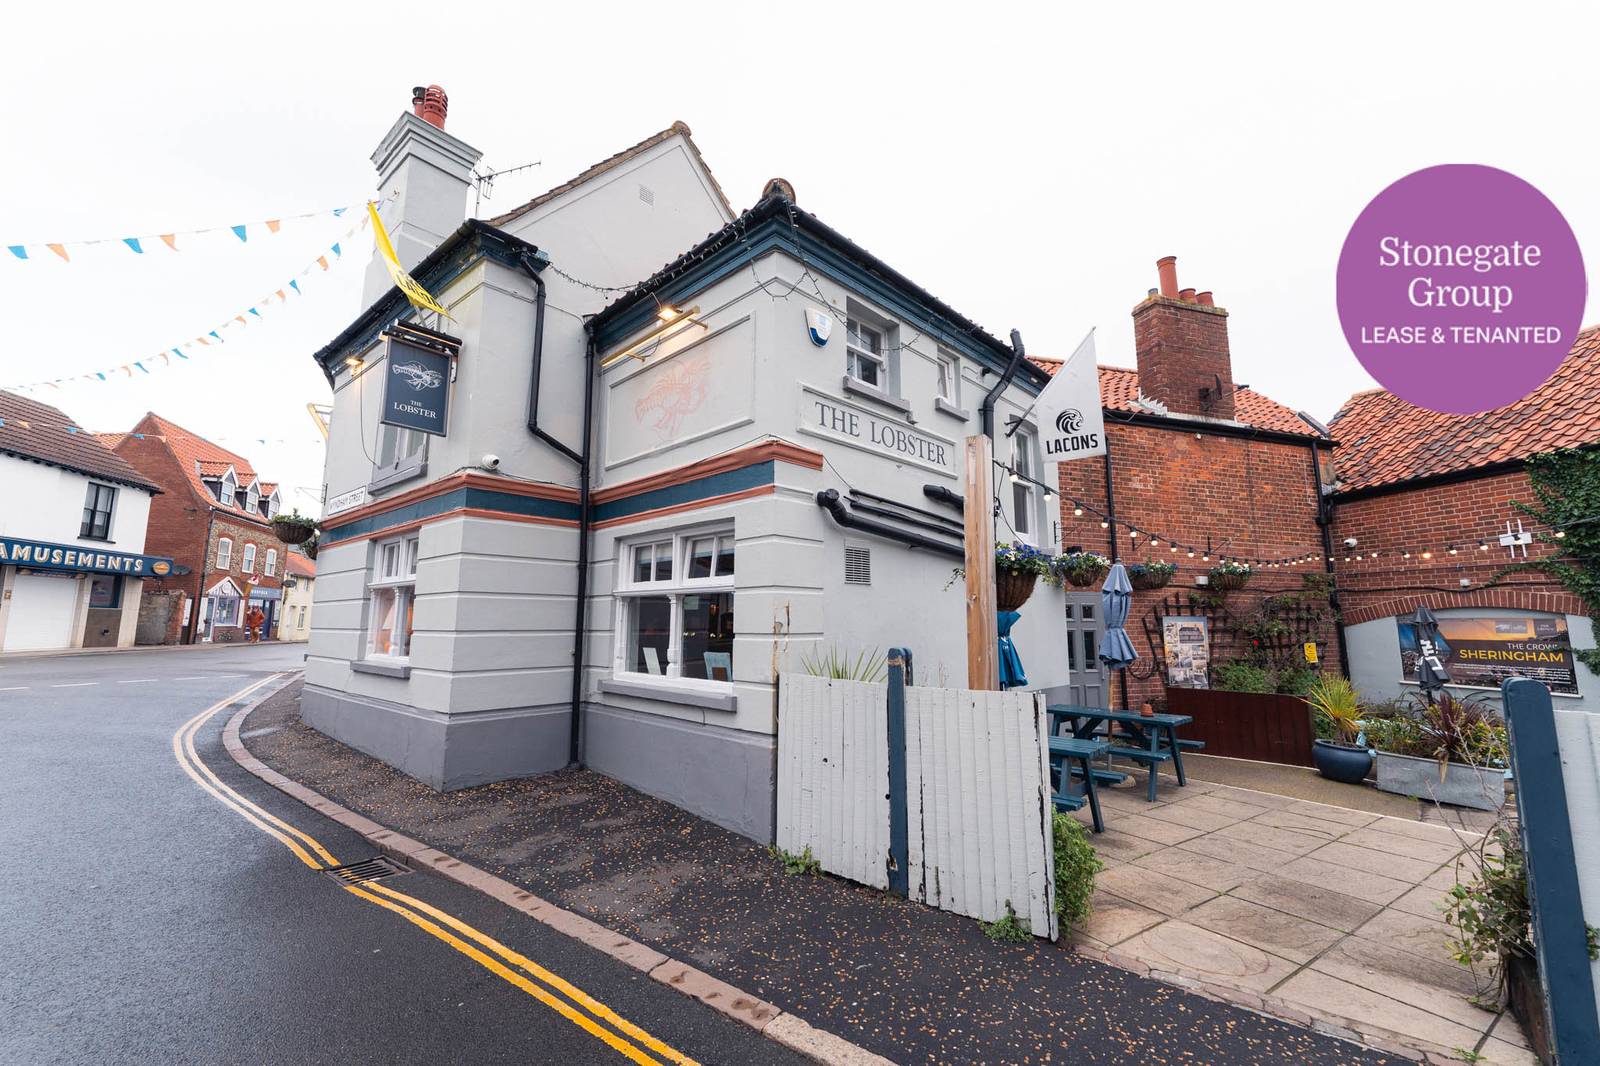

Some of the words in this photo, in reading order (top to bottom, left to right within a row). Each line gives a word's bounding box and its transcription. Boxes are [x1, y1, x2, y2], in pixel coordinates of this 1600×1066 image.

[394, 402, 437, 419] LOBSTER
[815, 401, 860, 437] THE
[869, 420, 947, 466] LOBSTER
[1046, 433, 1099, 455] LACONS
[1507, 642, 1525, 650] THE
[1459, 649, 1564, 663] SHERINGHAM
